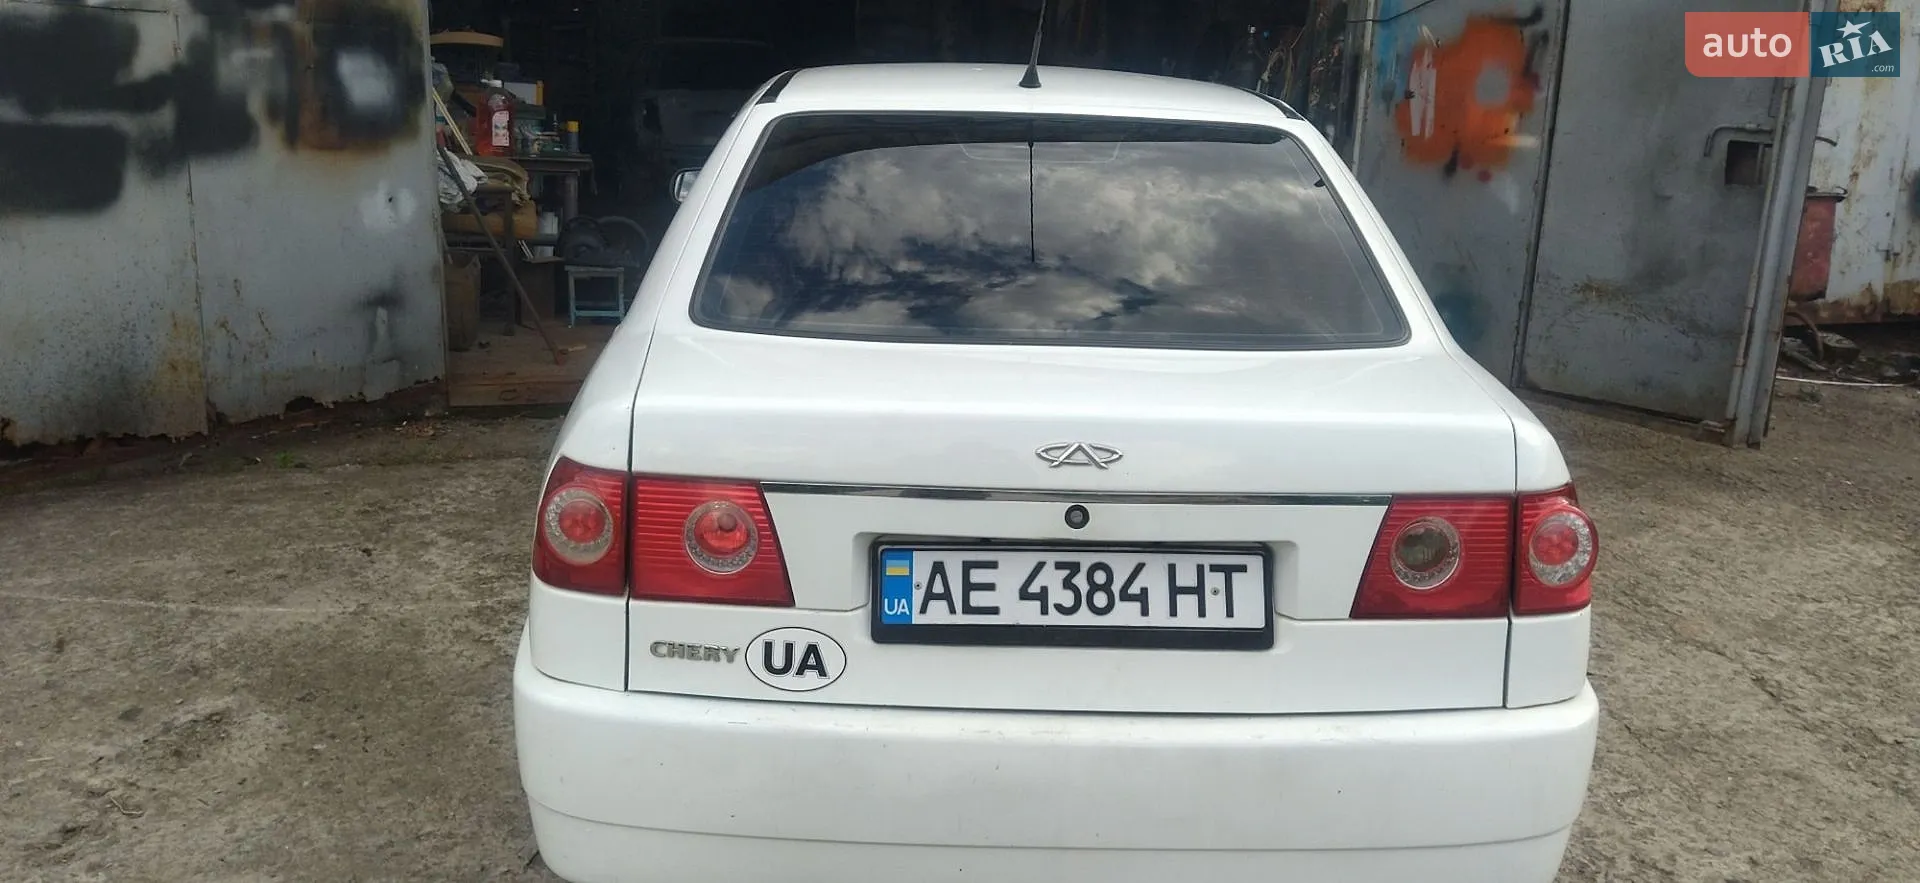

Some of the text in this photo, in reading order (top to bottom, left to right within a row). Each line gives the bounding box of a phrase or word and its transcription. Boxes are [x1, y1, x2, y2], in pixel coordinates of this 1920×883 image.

[919, 560, 1248, 618] AE 4384 HT
[884, 598, 910, 615] UA
[649, 640, 740, 664] CHERY
[762, 639, 830, 679] UA
